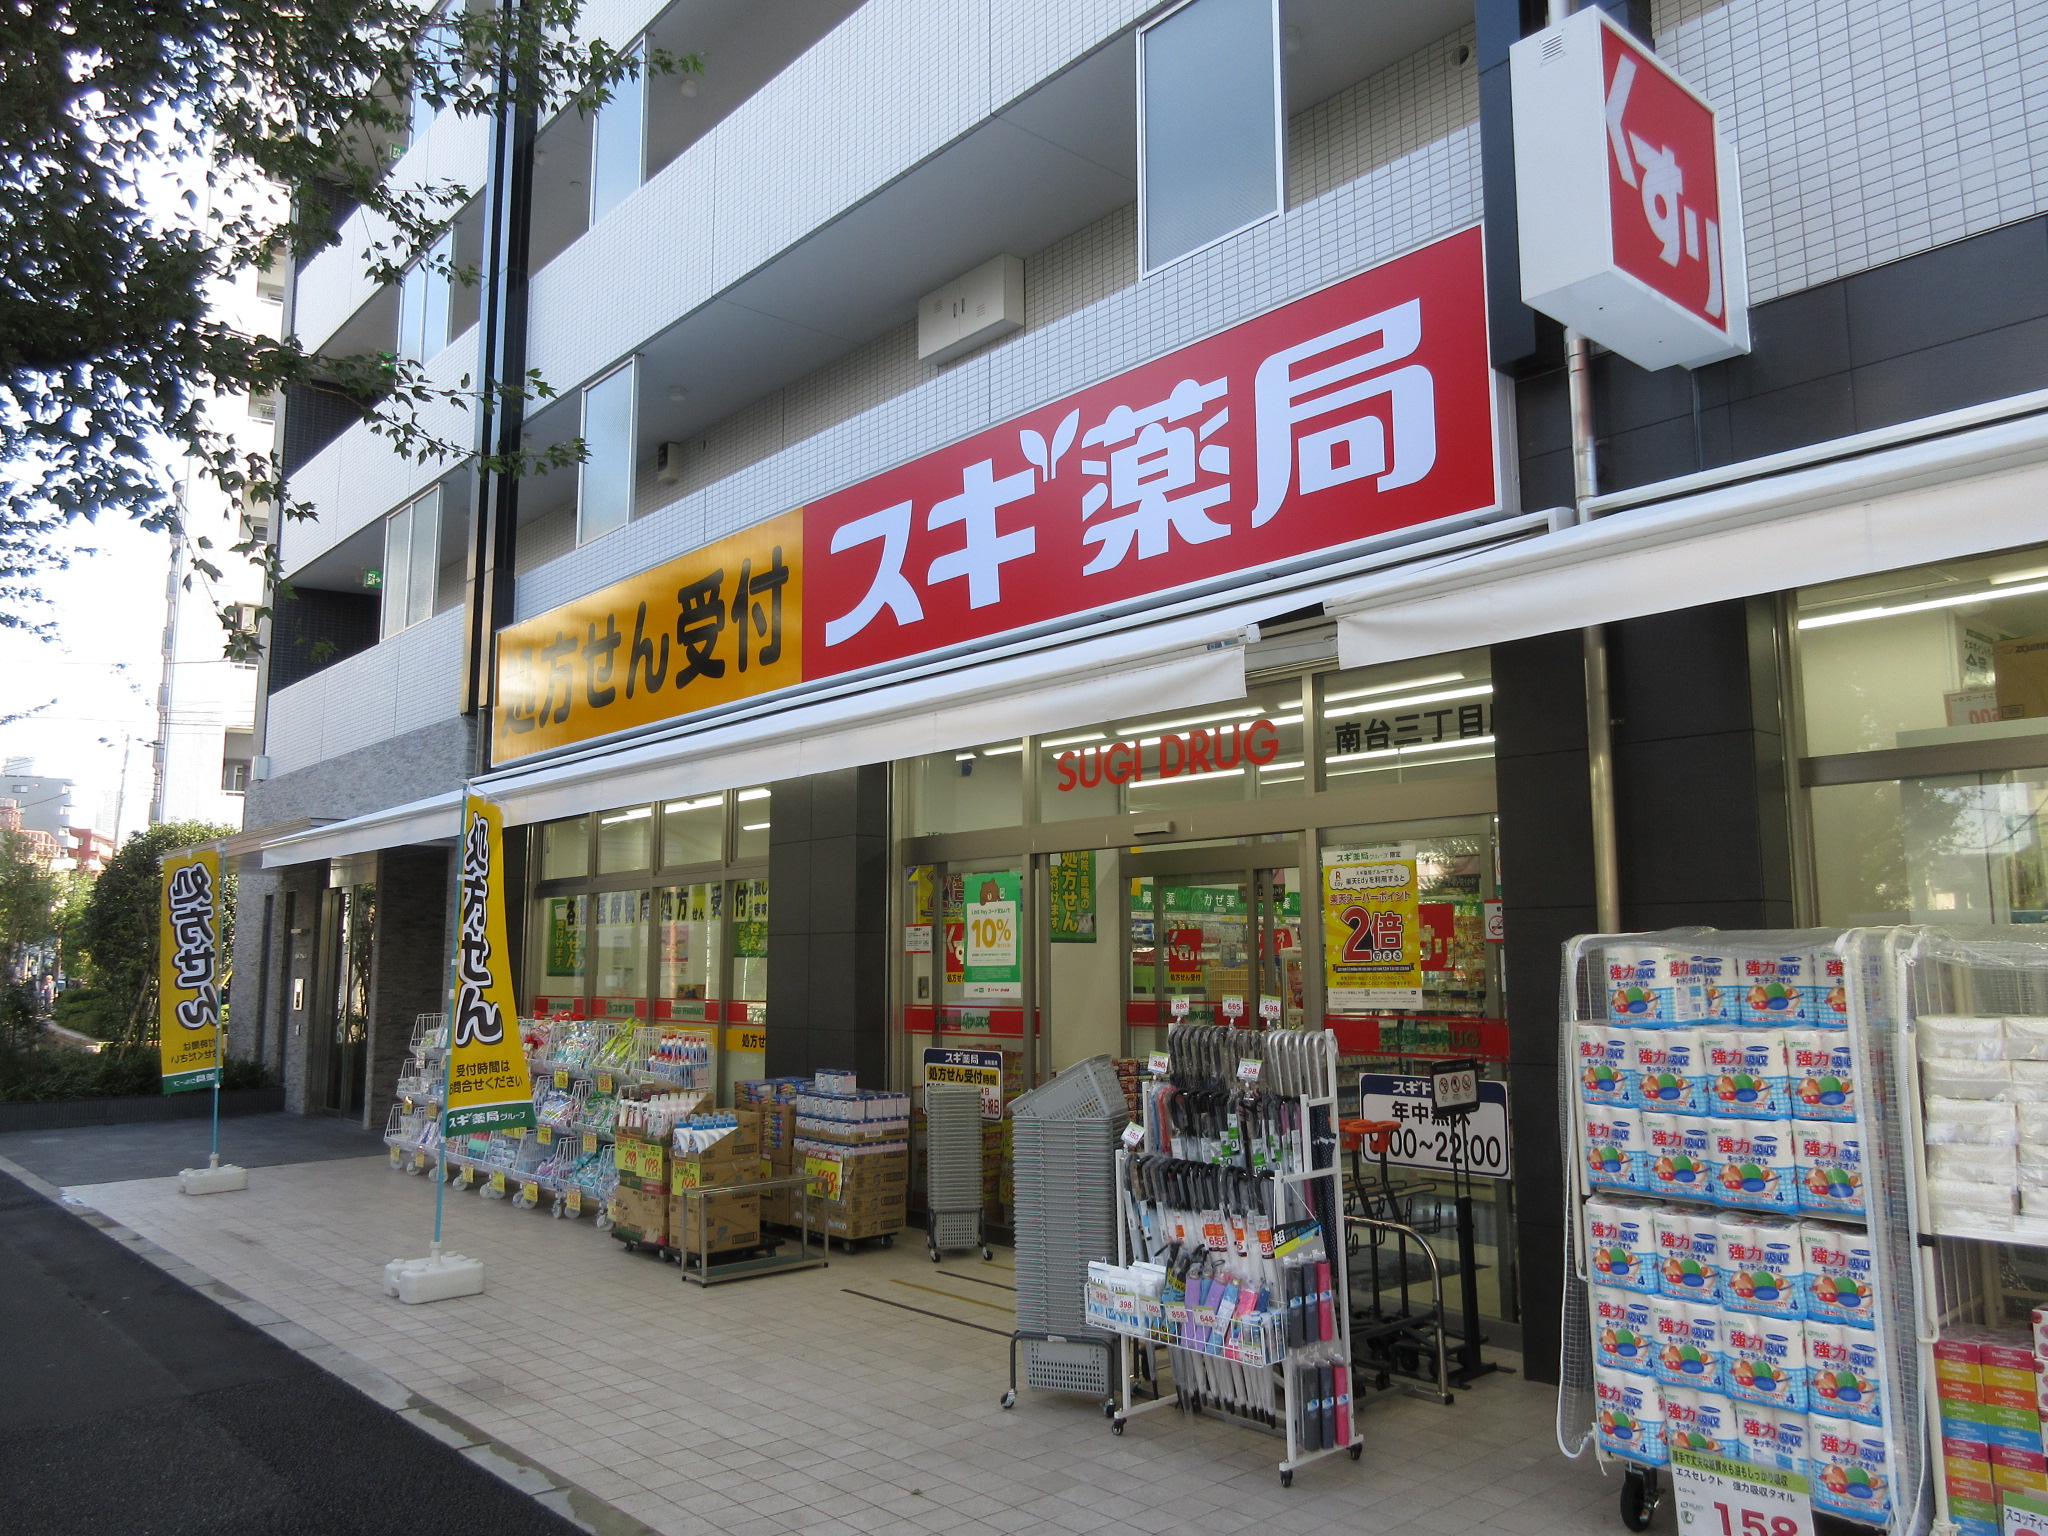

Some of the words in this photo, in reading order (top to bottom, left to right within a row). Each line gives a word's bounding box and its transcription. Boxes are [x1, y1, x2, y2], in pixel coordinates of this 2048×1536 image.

[1605, 54, 1724, 318] くすり
[824, 298, 1437, 646] スギ薬局
[1335, 703, 1494, 754] 南台三丁目
[1057, 739, 1142, 792] SUGI
[1161, 719, 1279, 779] DRUG
[1204, 893, 1235, 908] かぜ薬
[1330, 891, 1411, 905] 楽天スーパーポイント
[971, 918, 1012, 948] 10%
[1426, 1029, 1480, 1047] DRUG
[456, 1060, 510, 1077] 受付時間は
[945, 1052, 979, 1065] スギ薬局
[1676, 1467, 1723, 1487] エスセレクト
[1732, 1480, 1796, 1502] 強力吸収タオル
